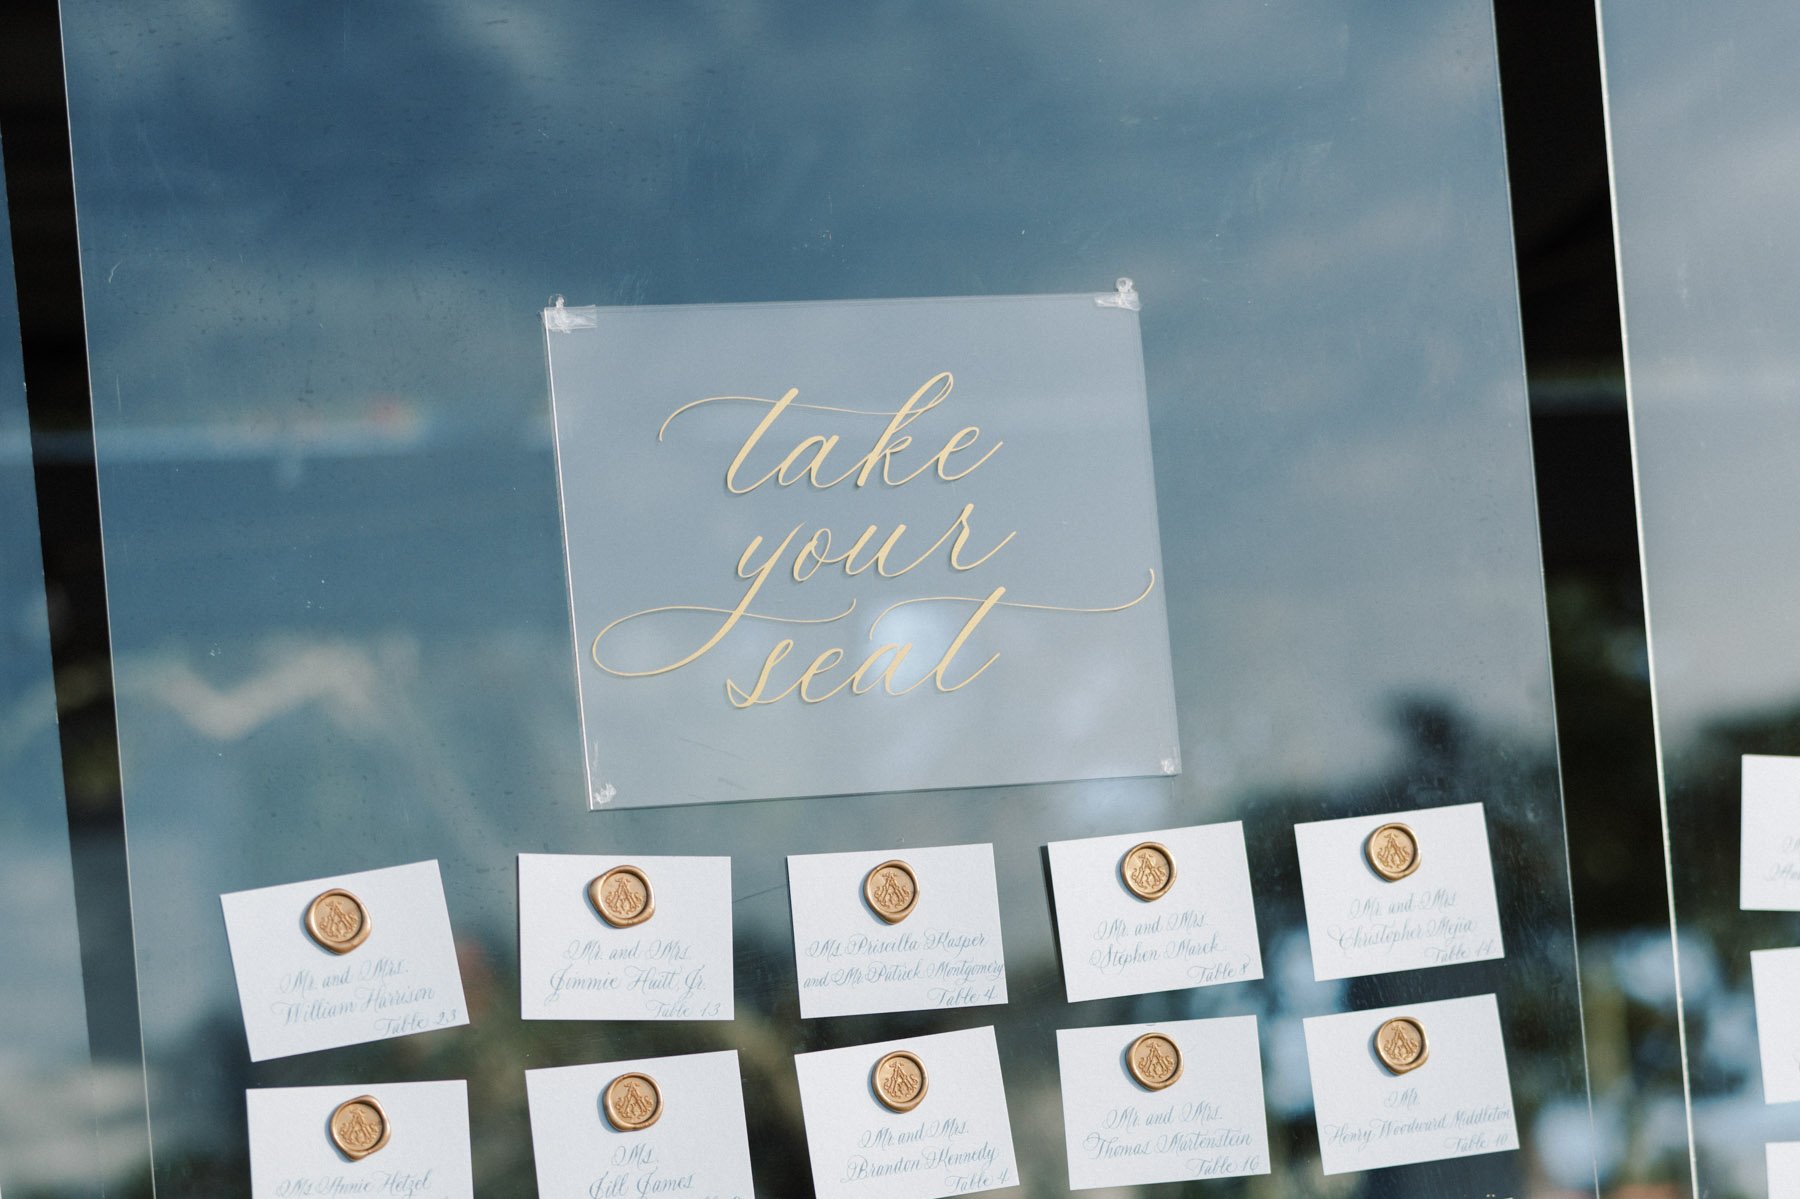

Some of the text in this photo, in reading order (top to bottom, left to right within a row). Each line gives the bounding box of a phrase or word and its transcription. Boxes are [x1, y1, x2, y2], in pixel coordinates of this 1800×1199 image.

[658, 371, 1004, 494] take
[592, 503, 1017, 677] your
[727, 568, 1155, 708] seat
[1389, 892, 1413, 913] and
[1135, 915, 1162, 936] and
[608, 940, 641, 960] and
[322, 966, 352, 988] and
[803, 971, 830, 988] and
[1187, 963, 1236, 983] Table
[271, 985, 436, 1025] William Harrison
[927, 987, 979, 1006] Table
[645, 999, 692, 1018] Table
[374, 1012, 429, 1036] Table
[1146, 1105, 1175, 1126] and
[898, 1122, 926, 1144] and
[840, 1155, 923, 1183] Brandon
[1187, 1156, 1237, 1177] Table
[945, 1173, 994, 1193] Table
